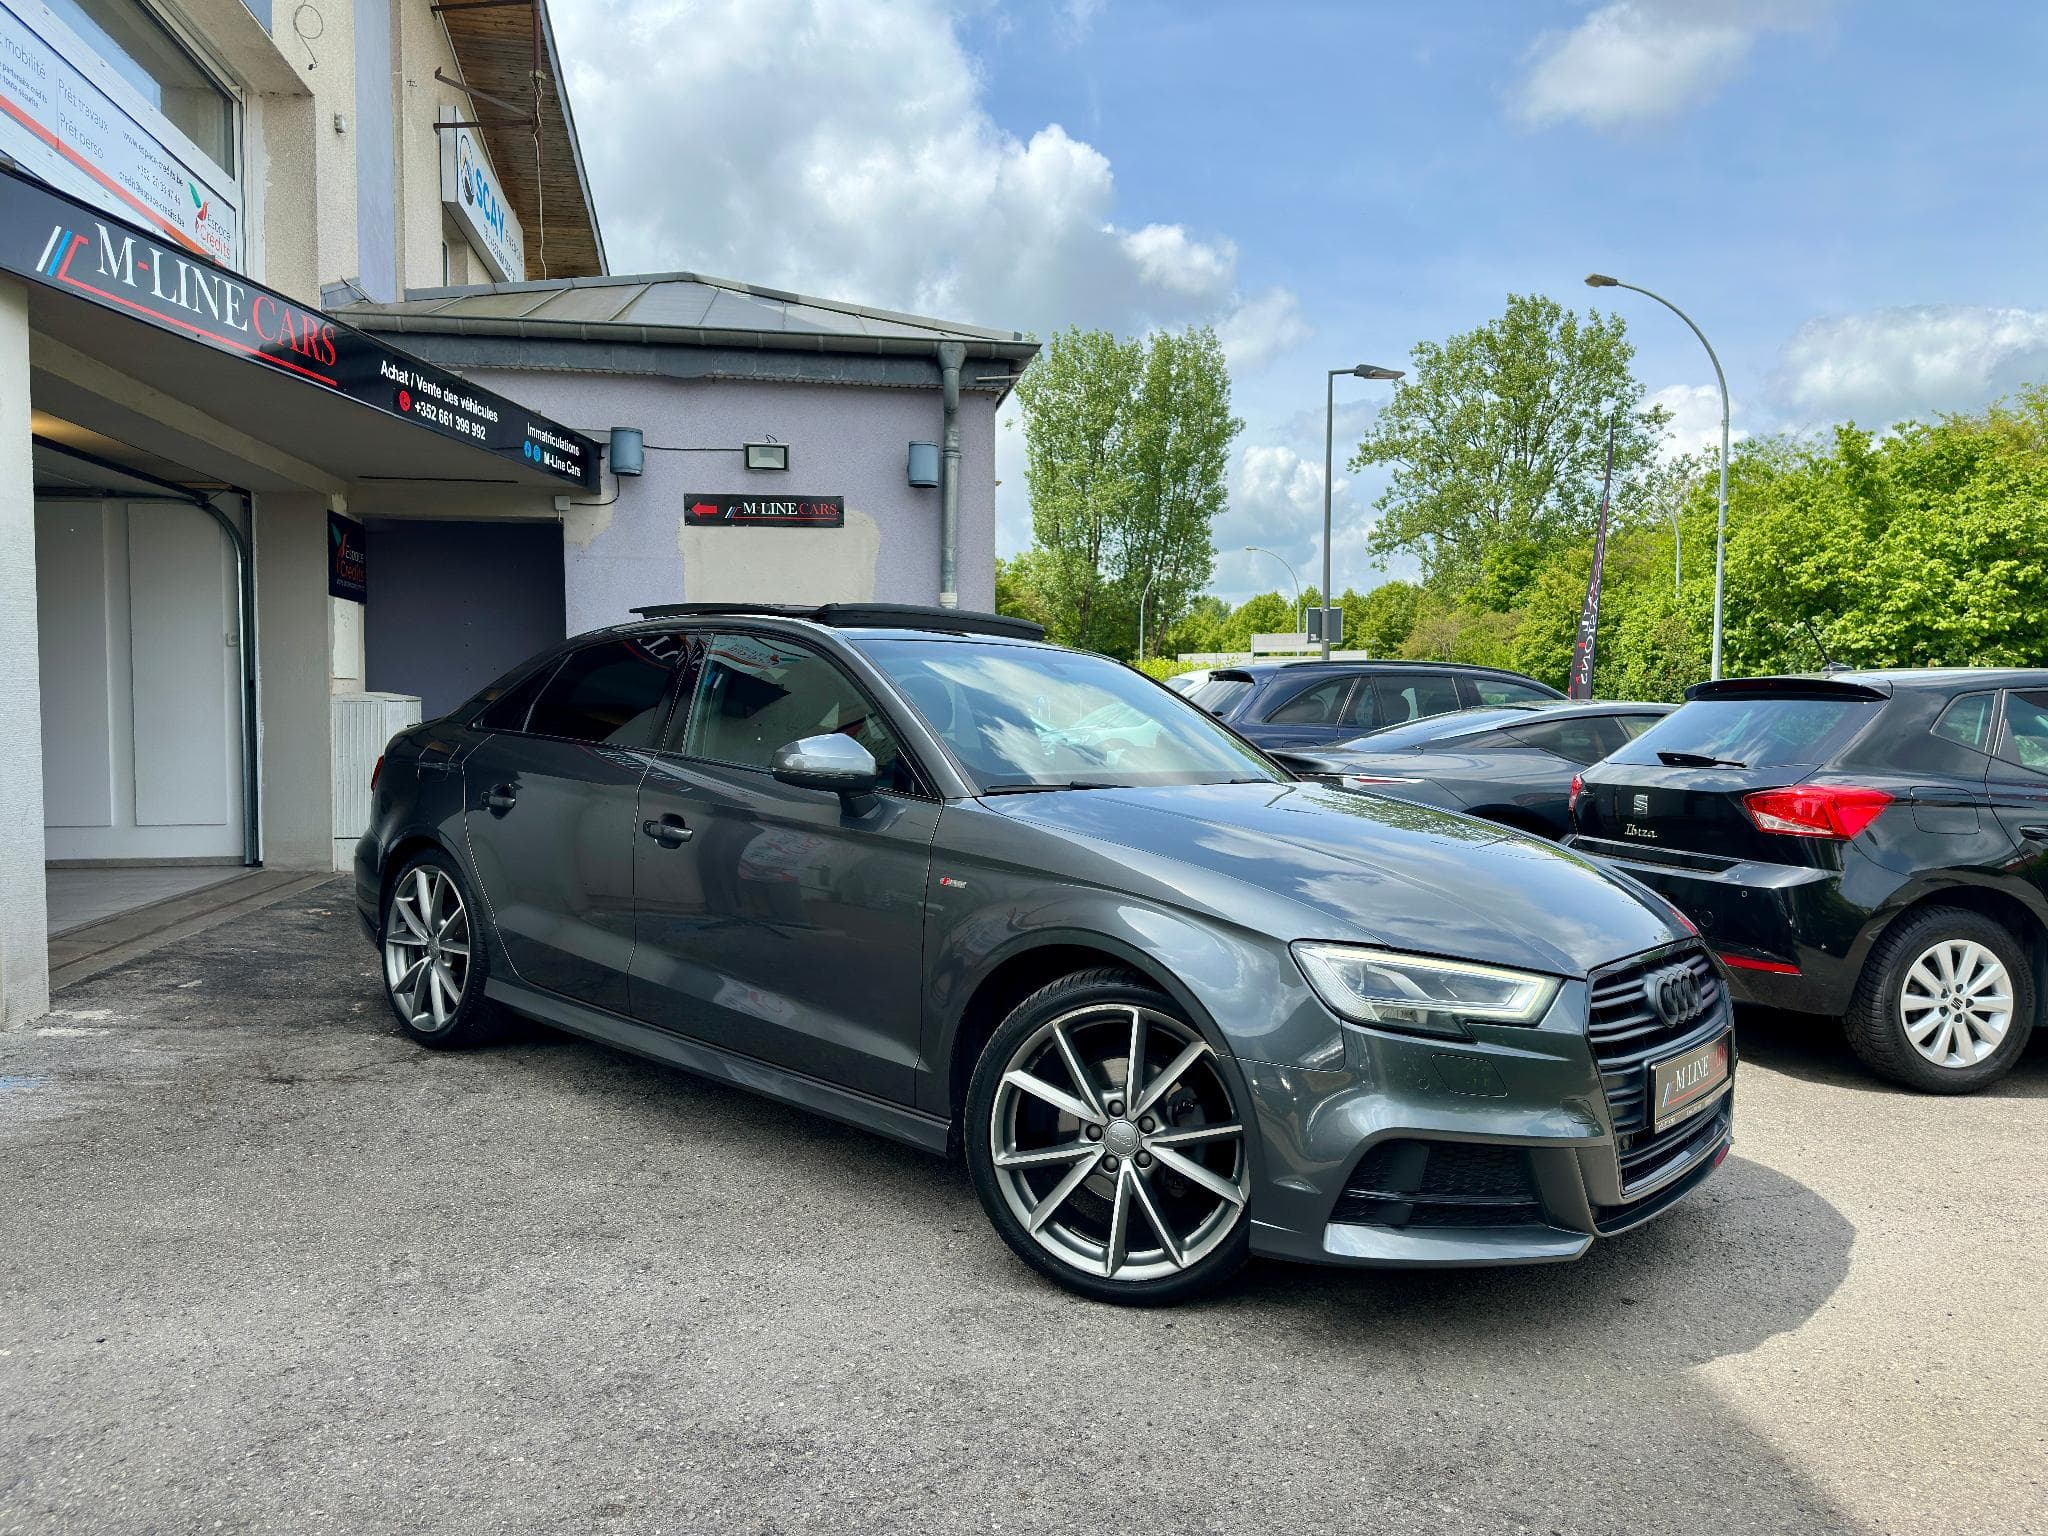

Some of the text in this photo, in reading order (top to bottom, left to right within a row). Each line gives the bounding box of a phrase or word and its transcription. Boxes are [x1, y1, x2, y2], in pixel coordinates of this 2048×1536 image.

[5, 38, 46, 80] mobilité
[59, 78, 77, 108] Prêt
[60, 112, 104, 159] Prêt perso
[475, 167, 505, 243] SCAY
[201, 224, 231, 260] Crédits
[94, 222, 338, 367] M-LINE CARS
[380, 360, 409, 386] Achat
[416, 374, 442, 399] Vente
[443, 387, 459, 406] des
[460, 394, 499, 423] véhicules
[414, 401, 486, 441] +352 661 399 992
[527, 422, 580, 457] Immatriculations
[543, 451, 581, 477] M-Line Cars
[743, 502, 838, 515] M-LINE CARS
[1624, 823, 1658, 838] Ibiza
